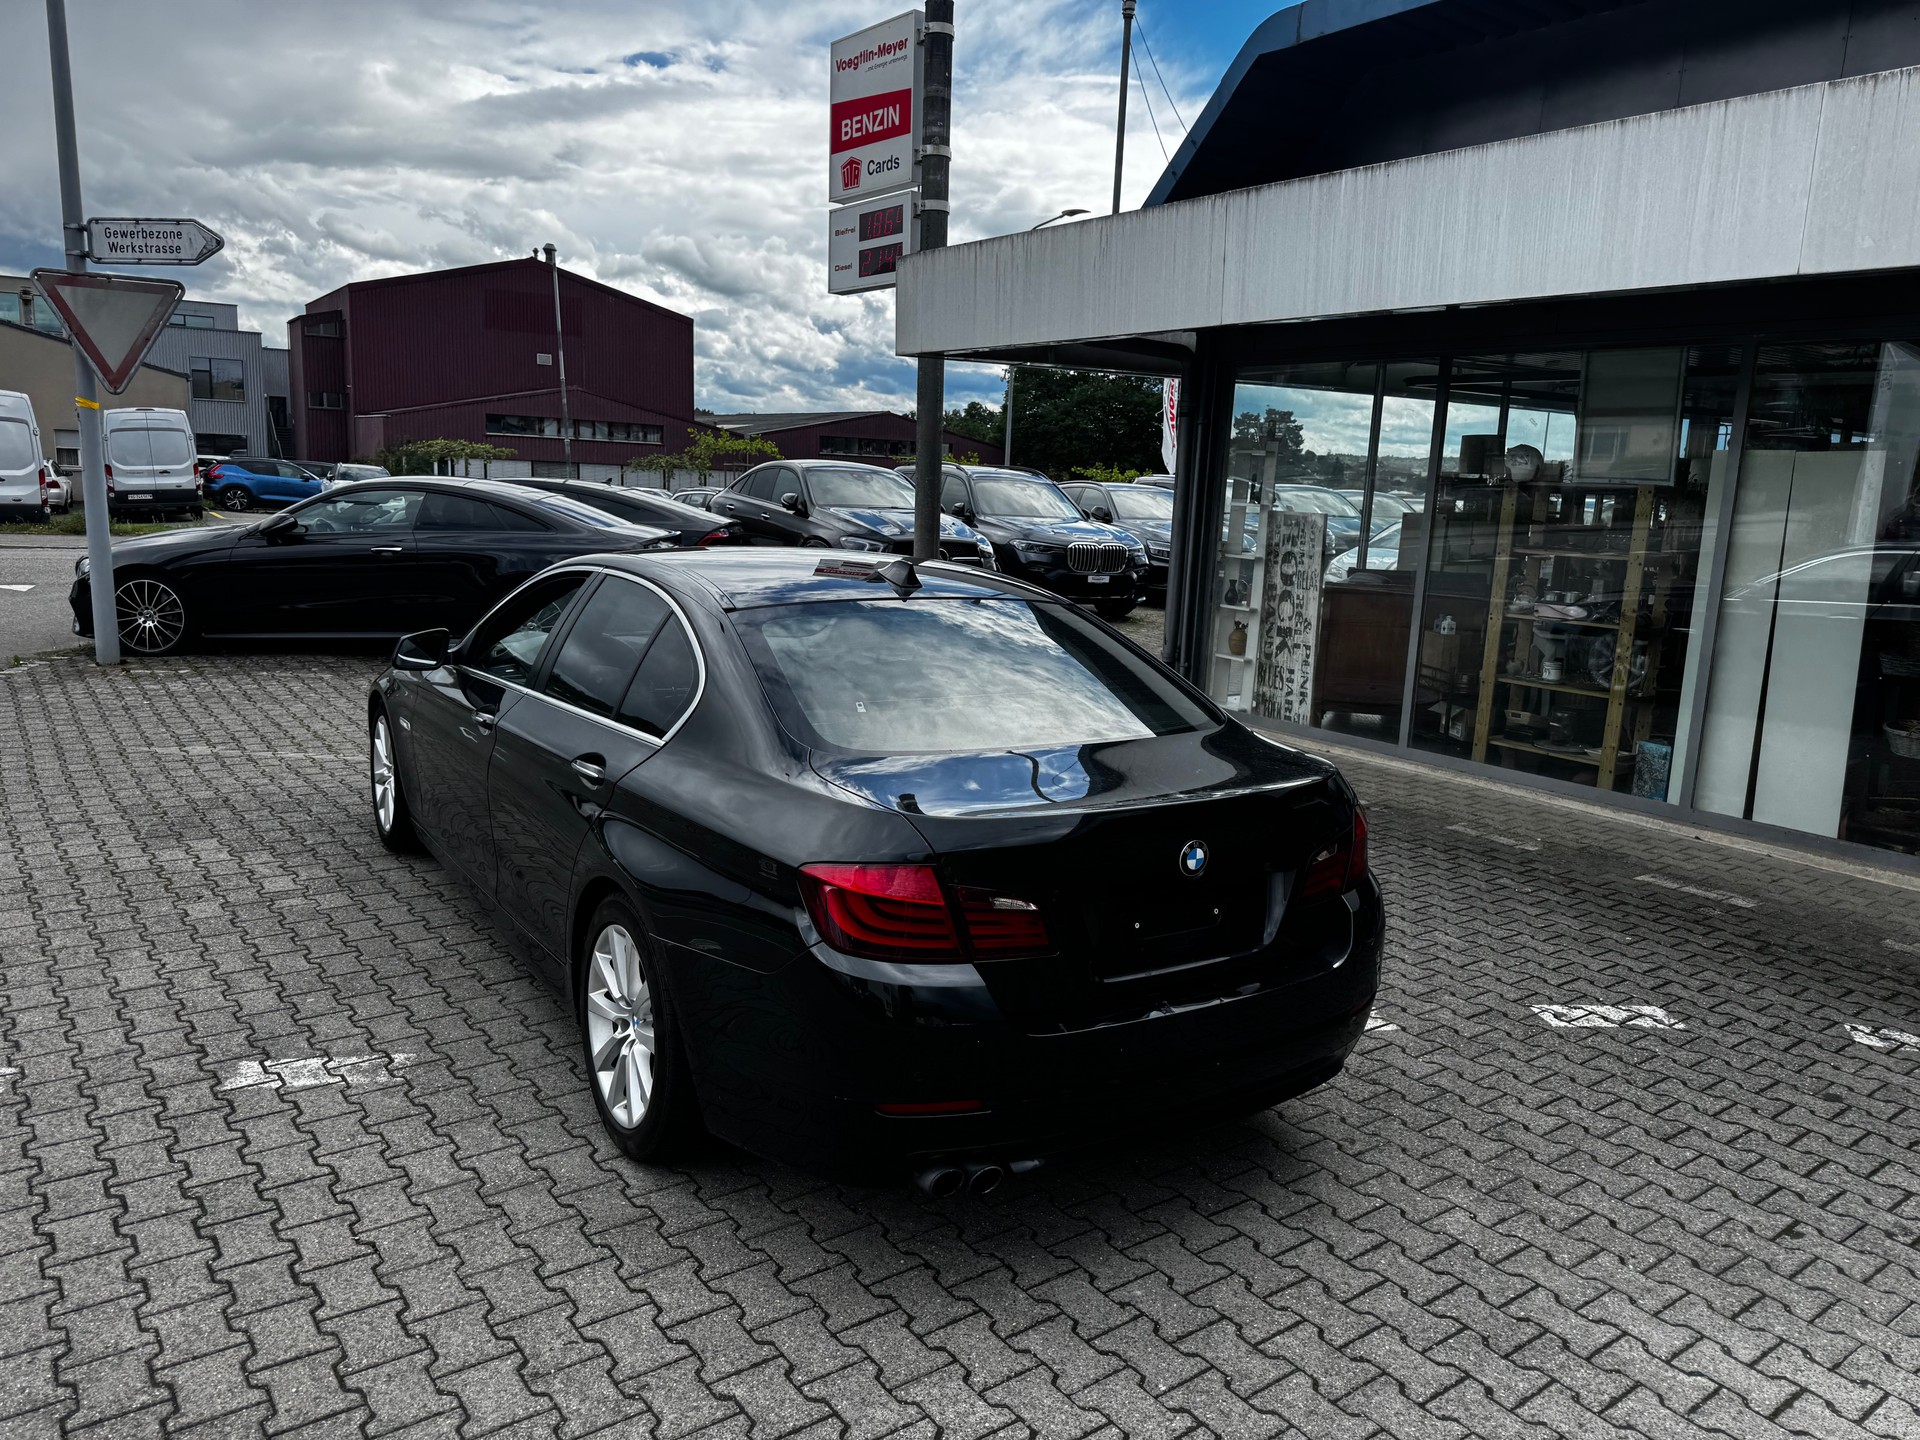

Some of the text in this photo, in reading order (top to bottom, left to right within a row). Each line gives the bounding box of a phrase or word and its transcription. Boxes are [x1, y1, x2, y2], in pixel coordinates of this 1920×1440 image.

[836, 38, 908, 72] Voegtlin-Meyer
[841, 103, 900, 141] BENZIN
[867, 155, 900, 176] Cards
[104, 227, 183, 240] Gewerbezone
[835, 226, 856, 237] Bleifrei
[108, 241, 182, 254] Werkstrasse
[834, 262, 853, 272] Diesel
[1299, 644, 1312, 706] PUNK
